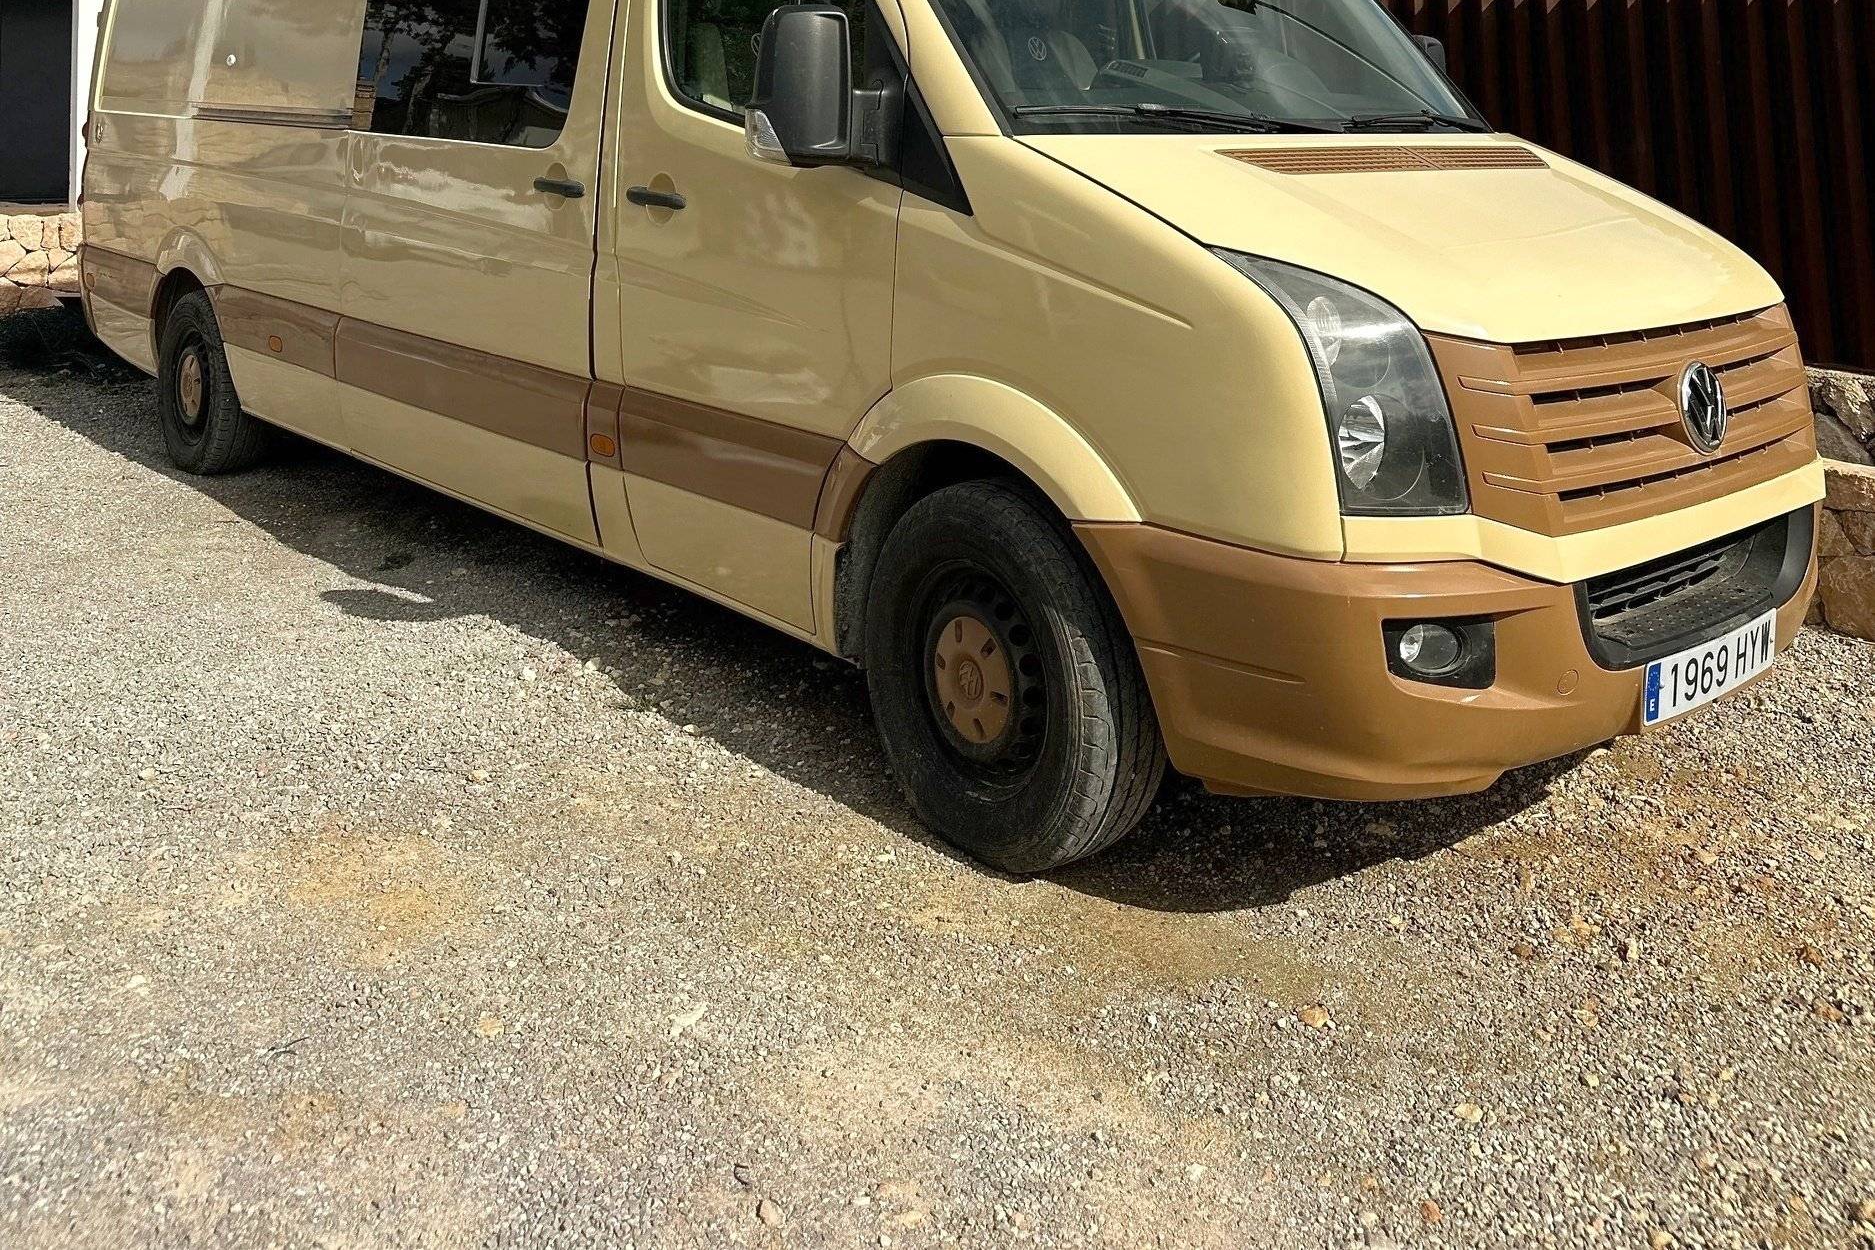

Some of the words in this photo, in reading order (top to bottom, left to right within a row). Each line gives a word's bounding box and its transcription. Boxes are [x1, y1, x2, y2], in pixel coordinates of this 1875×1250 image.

[1649, 698, 1656, 712] E
[1671, 644, 1729, 707] 1969
[1734, 619, 1771, 679] HYW
